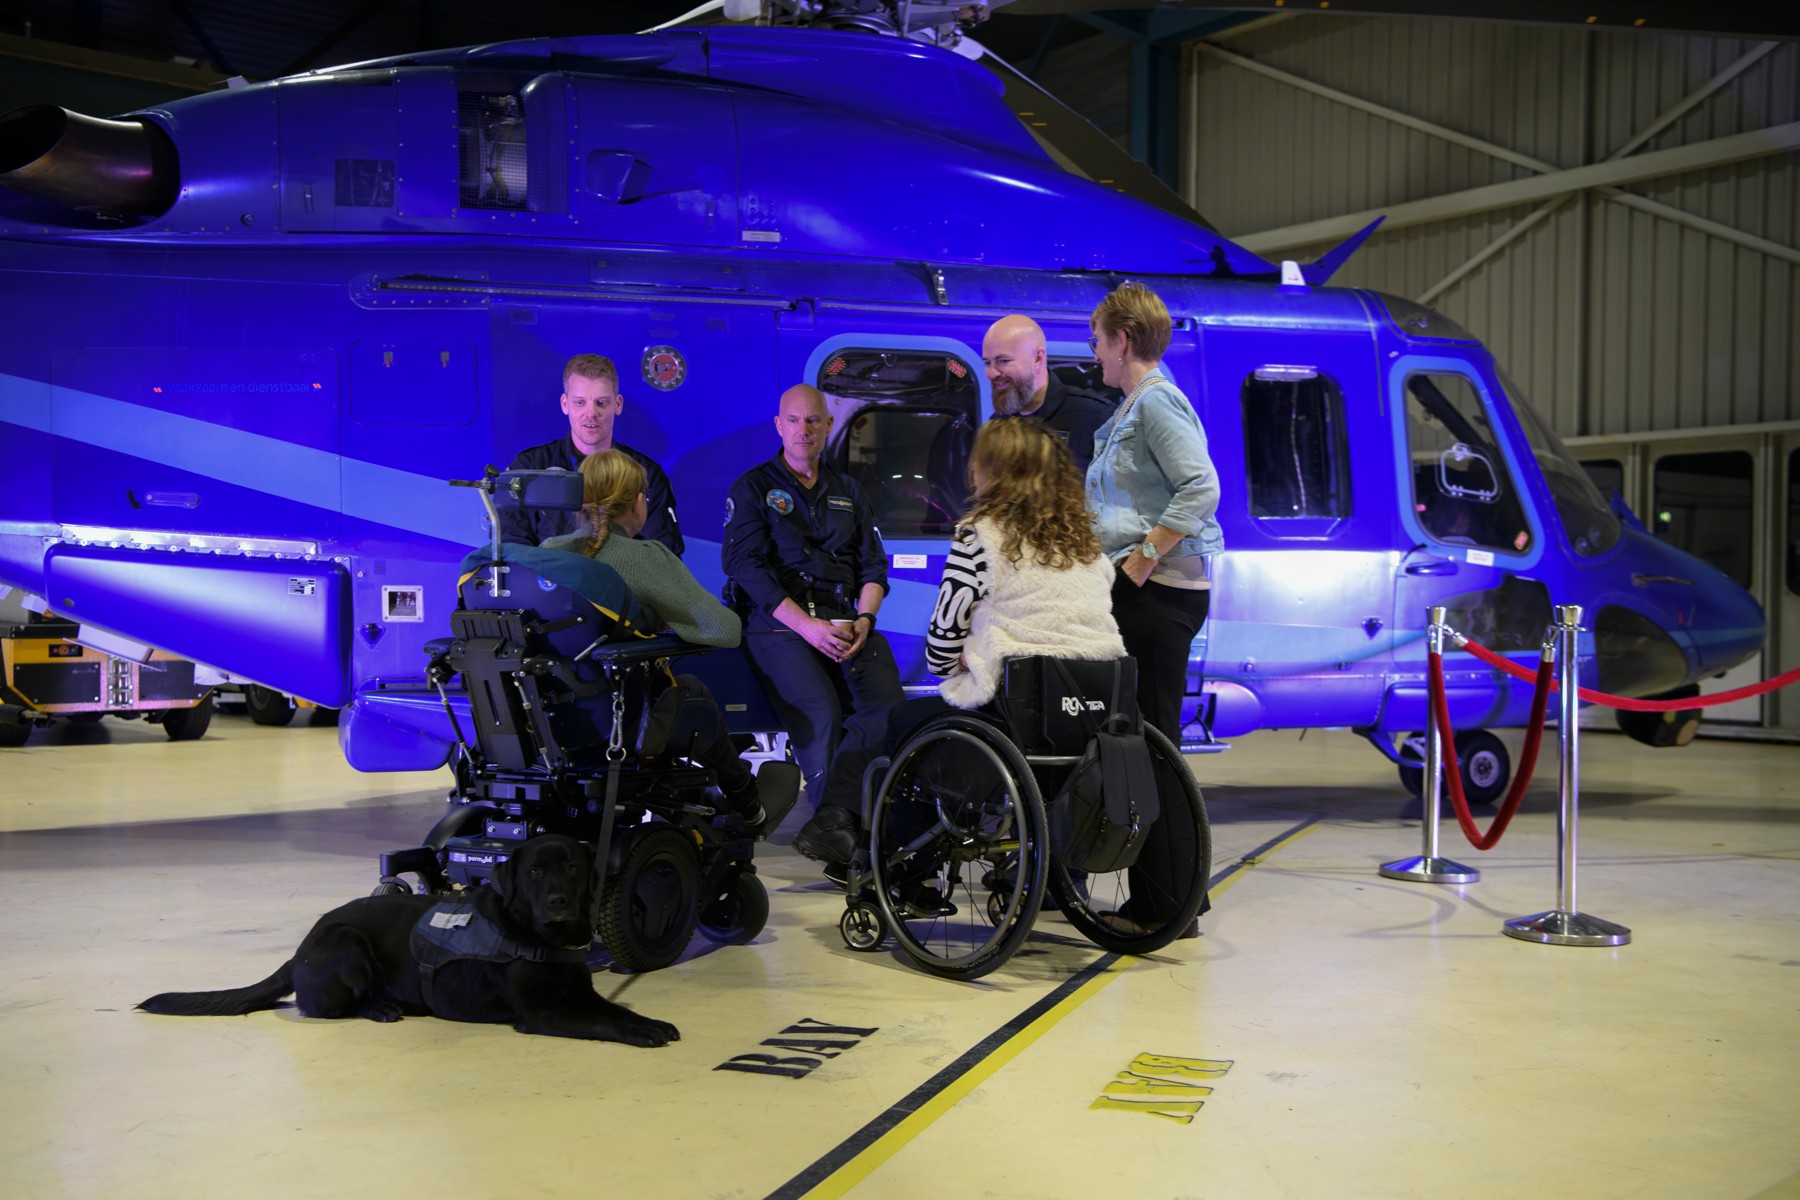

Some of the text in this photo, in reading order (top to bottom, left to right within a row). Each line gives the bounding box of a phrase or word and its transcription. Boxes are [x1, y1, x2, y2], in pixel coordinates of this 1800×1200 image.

[230, 383, 245, 393] en
[247, 381, 311, 393] dienstbaar
[712, 1017, 880, 1079] BAY
[1087, 1052, 1234, 1126] BAY
